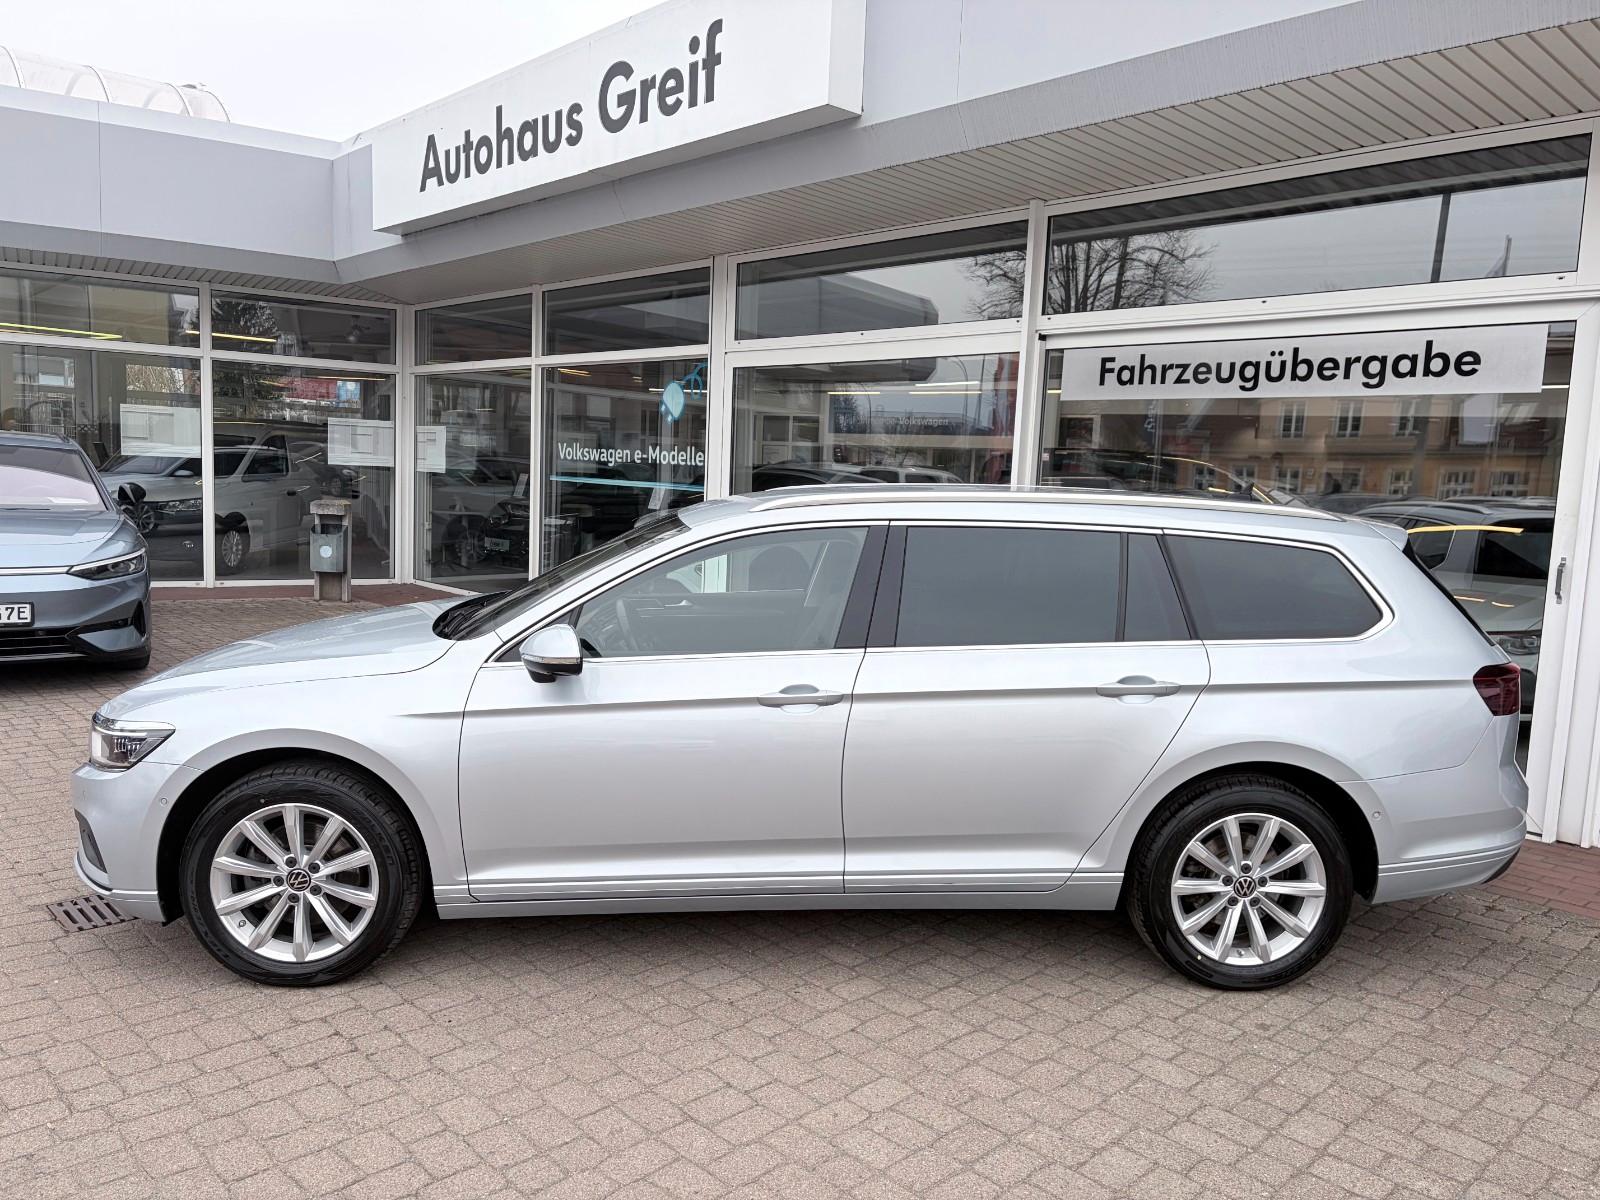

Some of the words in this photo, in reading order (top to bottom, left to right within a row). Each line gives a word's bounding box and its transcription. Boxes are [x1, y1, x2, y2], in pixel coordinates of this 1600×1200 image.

[419, 102, 583, 192] Autohaus
[598, 18, 723, 134] Greif
[1099, 340, 1481, 391] Fahrzeugübergabe
[558, 442, 631, 466] Volkswagen
[634, 445, 705, 466] e-Modelle
[0, 607, 28, 621] 7E
